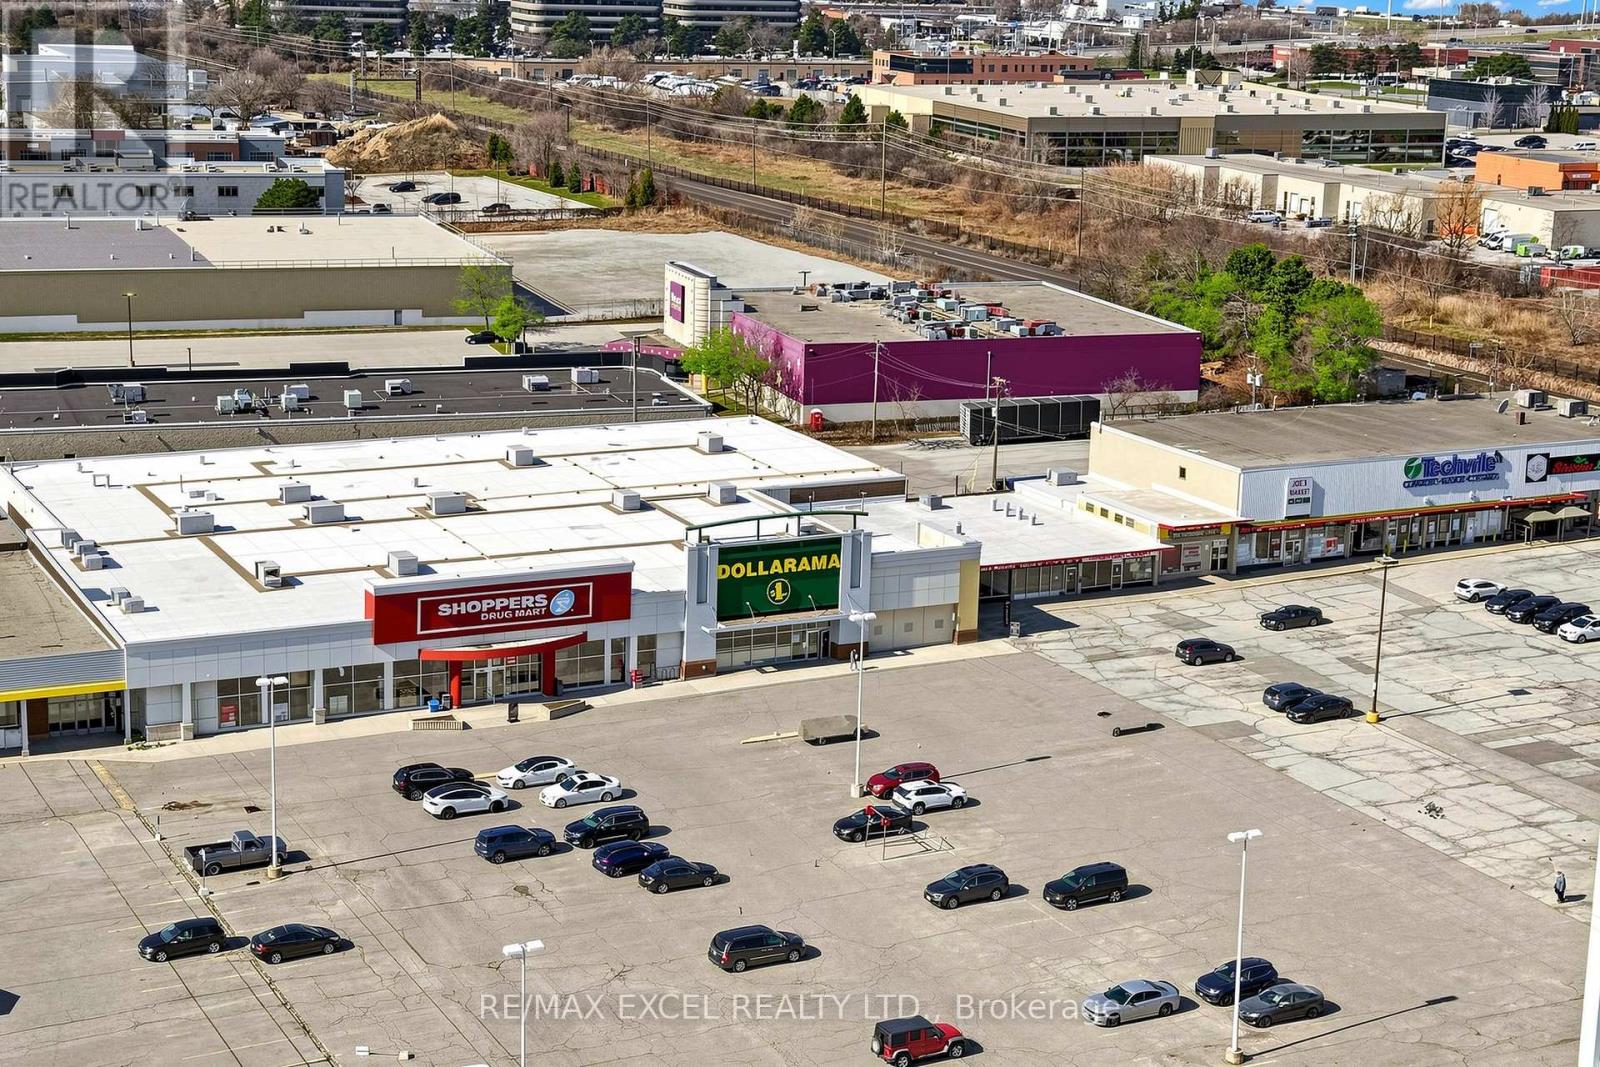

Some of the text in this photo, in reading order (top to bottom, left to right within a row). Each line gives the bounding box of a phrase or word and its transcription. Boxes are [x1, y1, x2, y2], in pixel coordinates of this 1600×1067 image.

[1421, 452, 1497, 478] Techville
[716, 553, 841, 580] DOLLARAMA
[437, 593, 548, 616] SHOPPERS
[480, 607, 547, 621] DRUG MART
